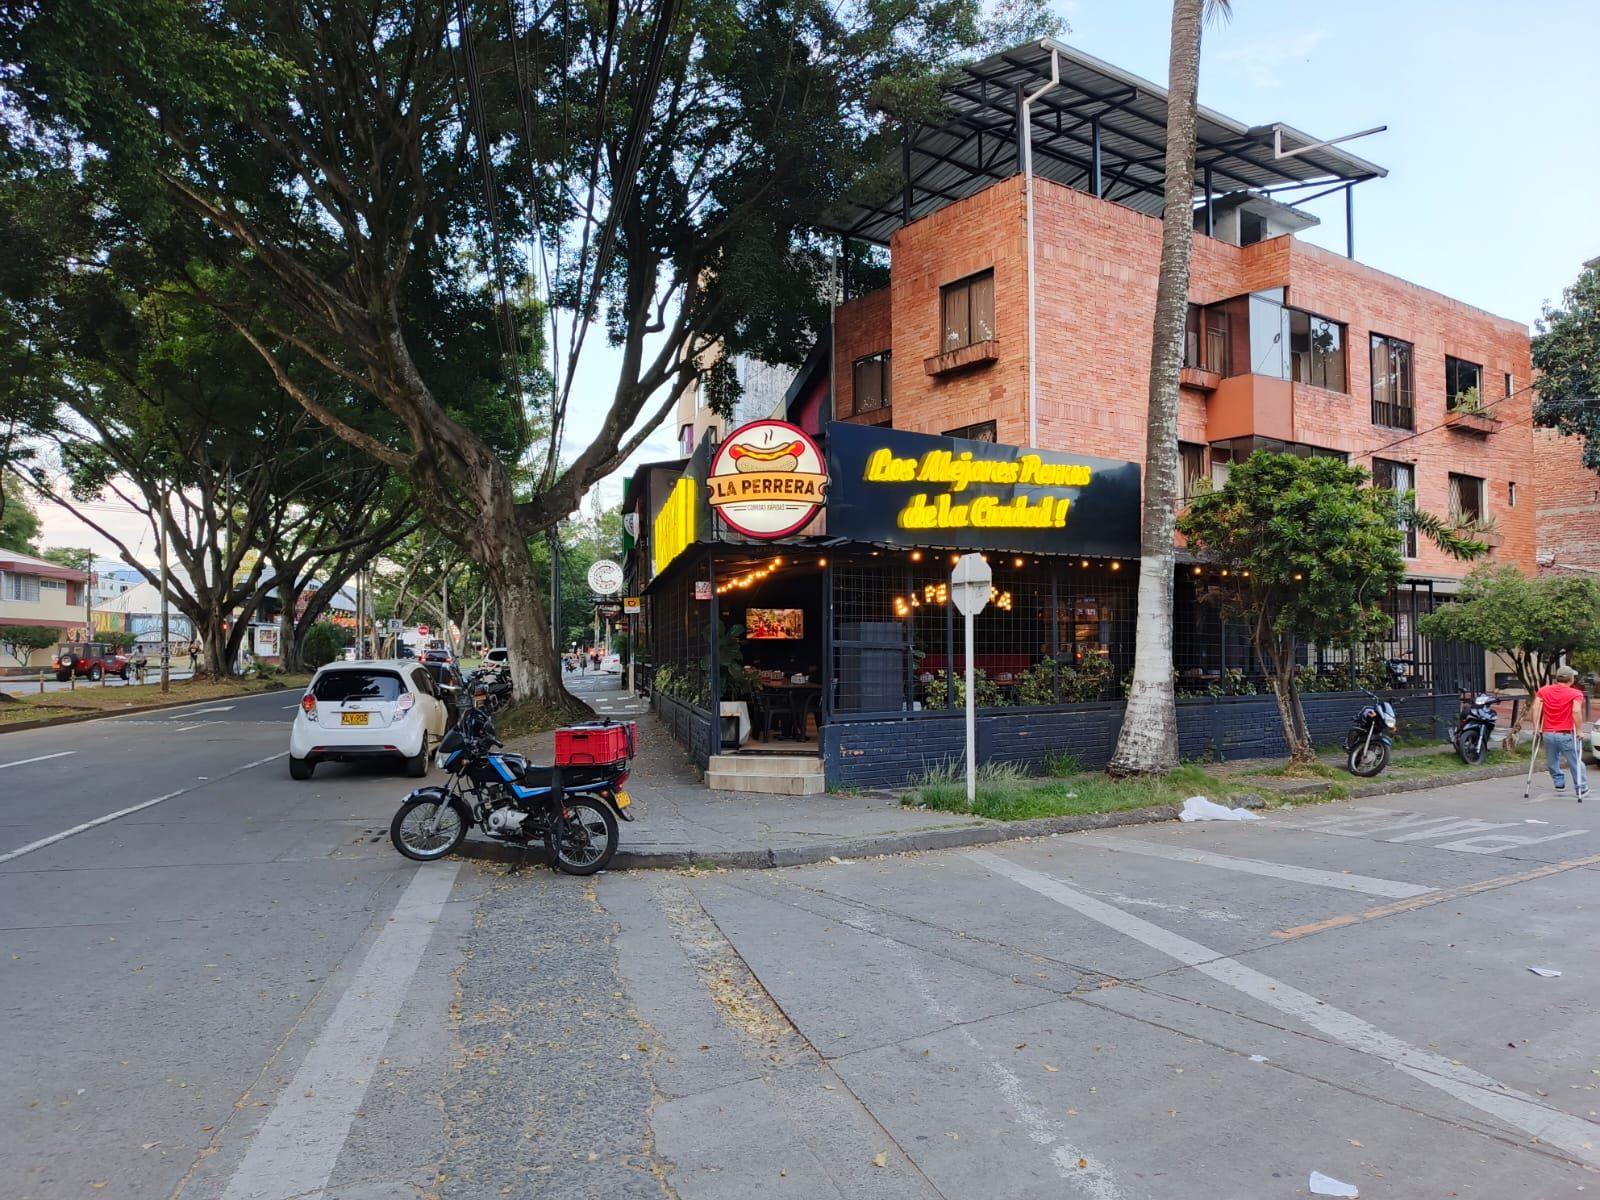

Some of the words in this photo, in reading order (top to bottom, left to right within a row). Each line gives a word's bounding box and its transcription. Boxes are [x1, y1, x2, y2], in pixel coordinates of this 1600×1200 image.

[717, 482, 737, 497] LA
[741, 478, 815, 495] PERRERA
[864, 448, 917, 482] Los
[917, 450, 1019, 492] Mejores
[1019, 454, 1092, 486] Perros
[899, 493, 937, 528] de
[937, 494, 969, 528] la
